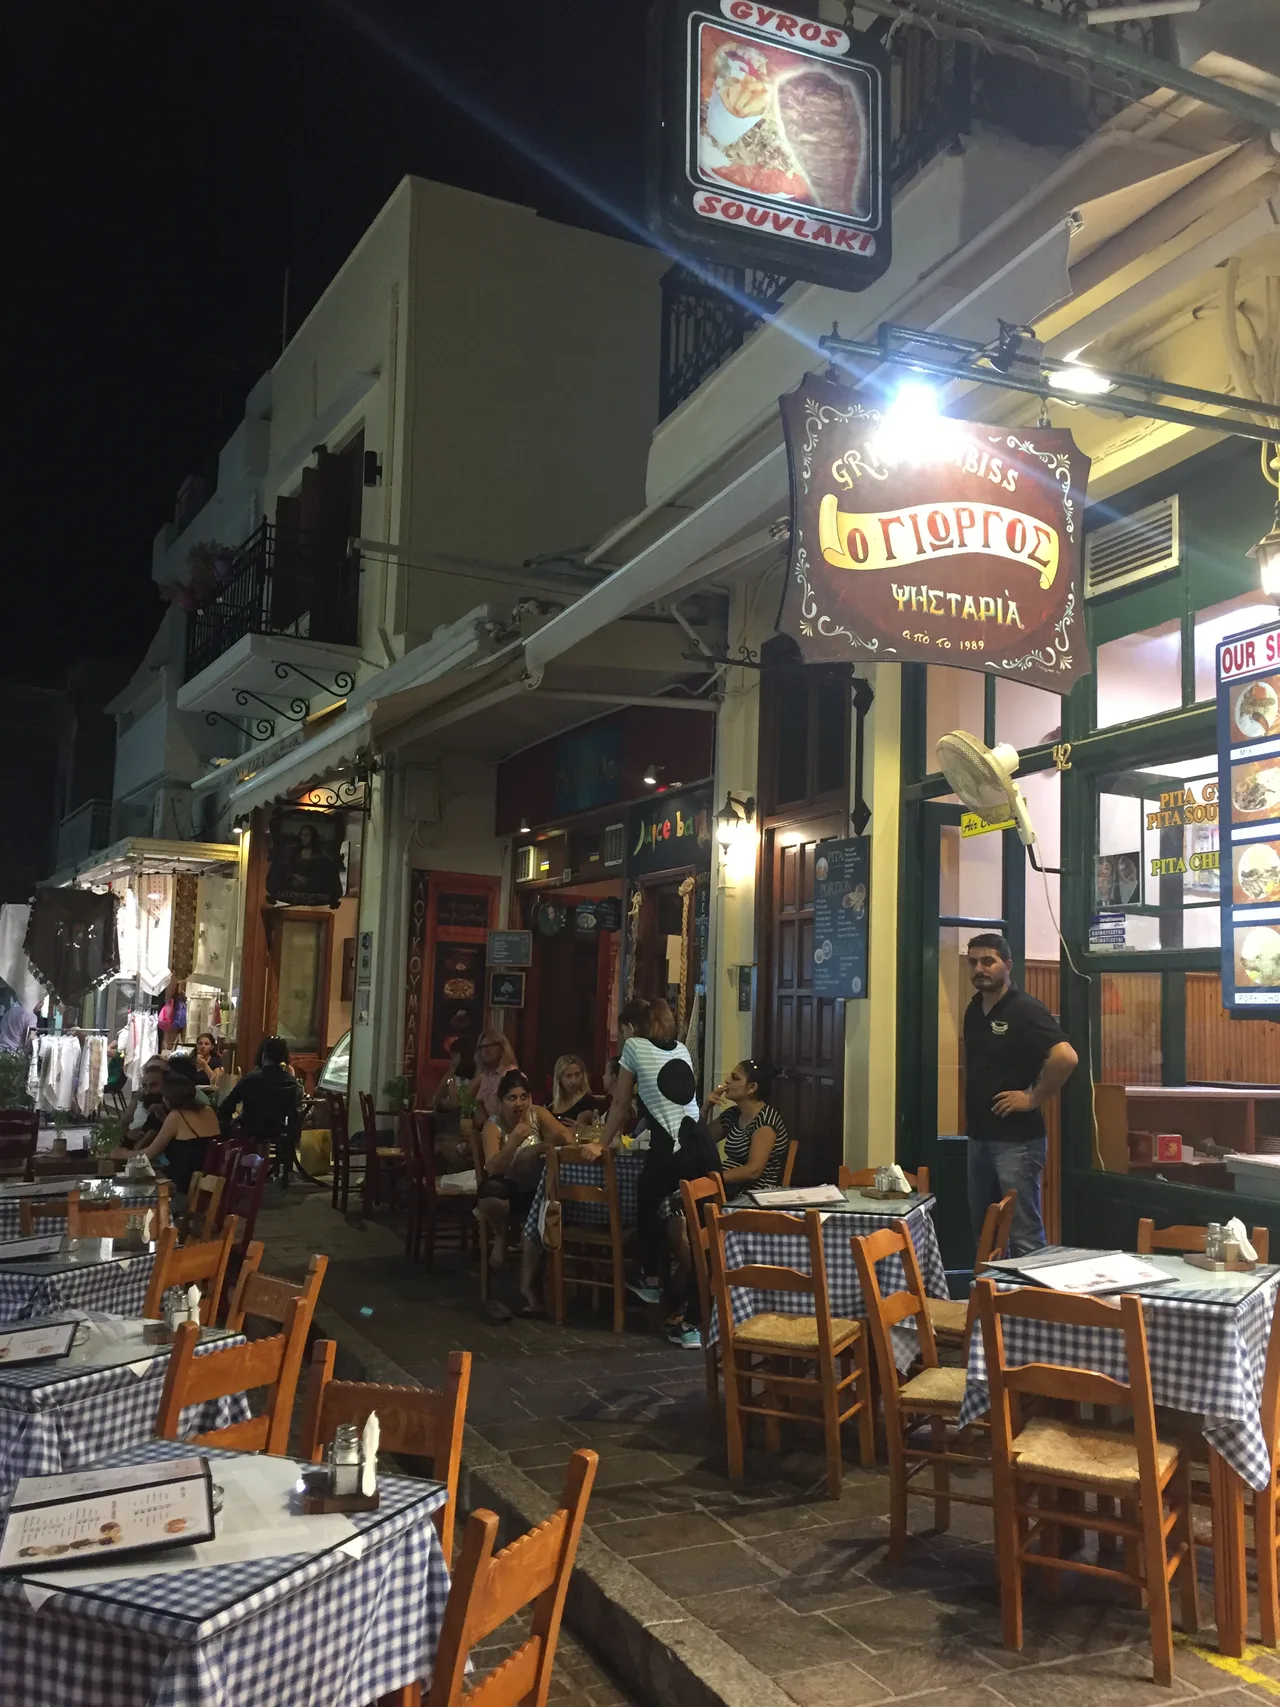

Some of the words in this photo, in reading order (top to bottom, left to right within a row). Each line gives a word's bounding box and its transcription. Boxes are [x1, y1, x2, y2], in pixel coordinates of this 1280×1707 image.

[729, 0, 842, 49] GYROS
[698, 196, 873, 252] SOUVLAKI
[960, 640, 985, 650] 1989
[1222, 641, 1256, 674] OUR
[1266, 632, 1280, 661] S
[1052, 743, 1072, 771] 42
[1159, 787, 1196, 809] PITA
[963, 819, 978, 833] Air
[1147, 810, 1182, 830] PITA
[1150, 857, 1187, 876] PITA
